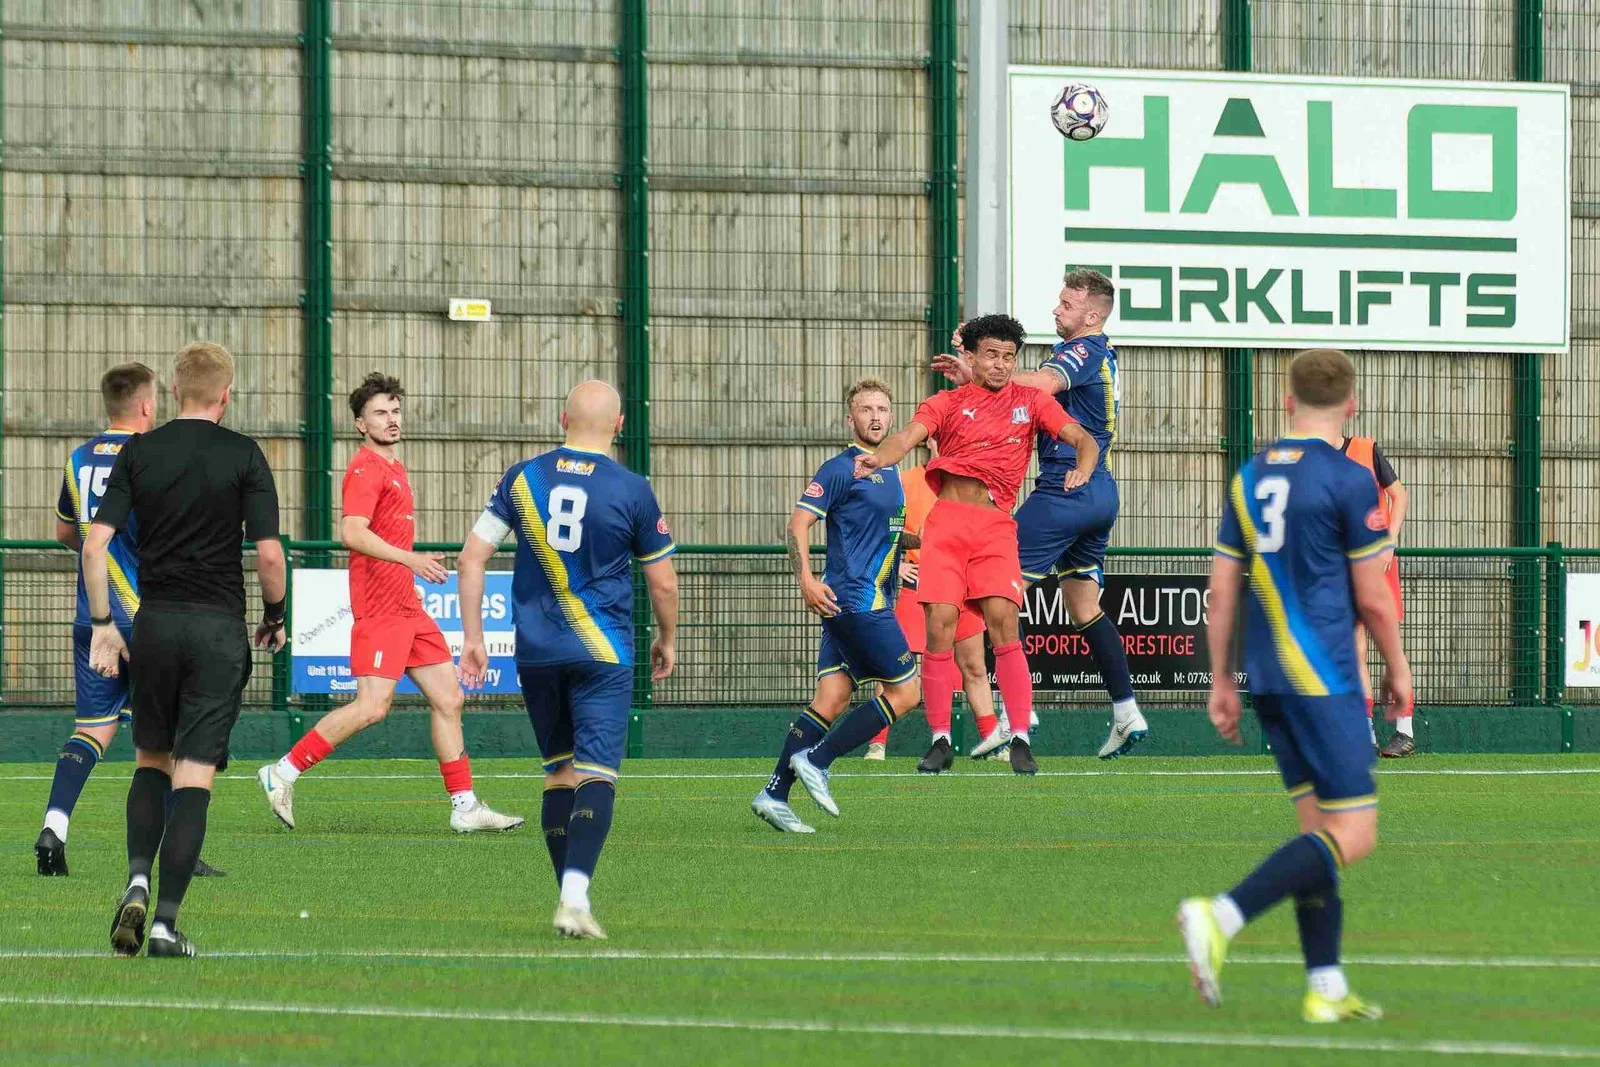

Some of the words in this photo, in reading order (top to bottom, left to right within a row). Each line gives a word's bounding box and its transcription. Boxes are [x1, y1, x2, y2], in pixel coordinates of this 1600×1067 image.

[1064, 94, 1517, 222] HALO
[546, 485, 588, 553] 8
[1255, 475, 1290, 553] 3
[1025, 634, 1091, 655] SPORTS
